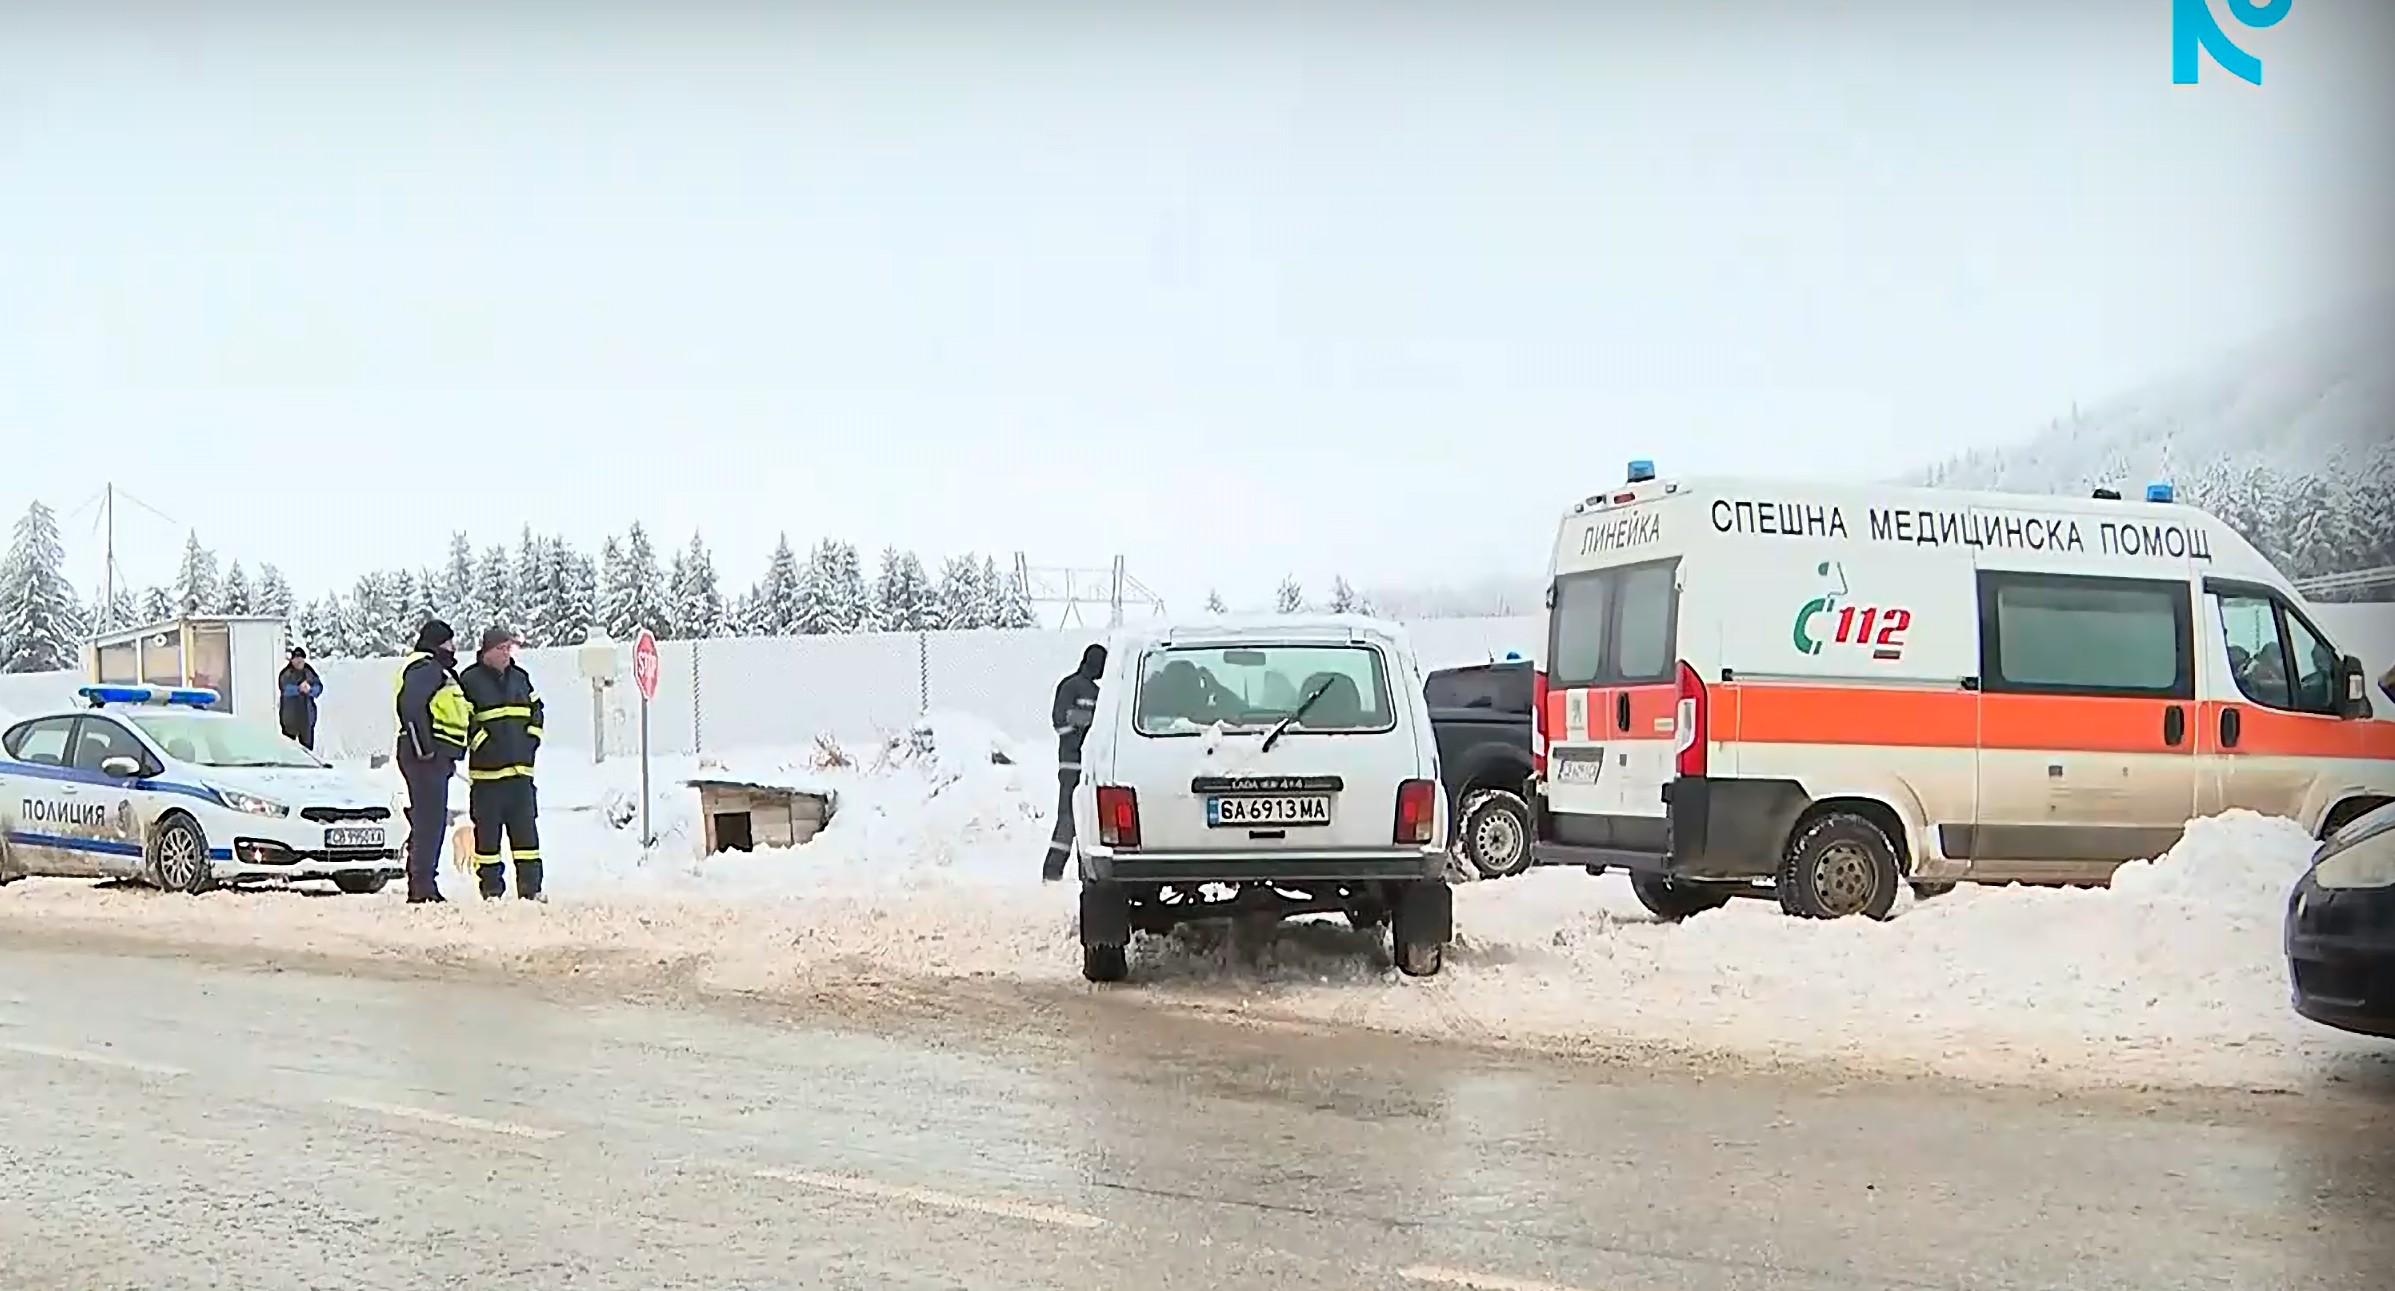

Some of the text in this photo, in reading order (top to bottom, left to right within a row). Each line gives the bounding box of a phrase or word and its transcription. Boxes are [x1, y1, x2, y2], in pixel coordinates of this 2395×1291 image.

[1581, 510, 1660, 555] ЛИНЕЙКА
[1712, 500, 2212, 564] СПЕШНА МЕДИЦИНСКА ПОМОЩ
[1835, 606, 1911, 646] 112
[638, 651, 657, 678] STOP
[22, 799, 105, 825] ПОЛИЦИЯ
